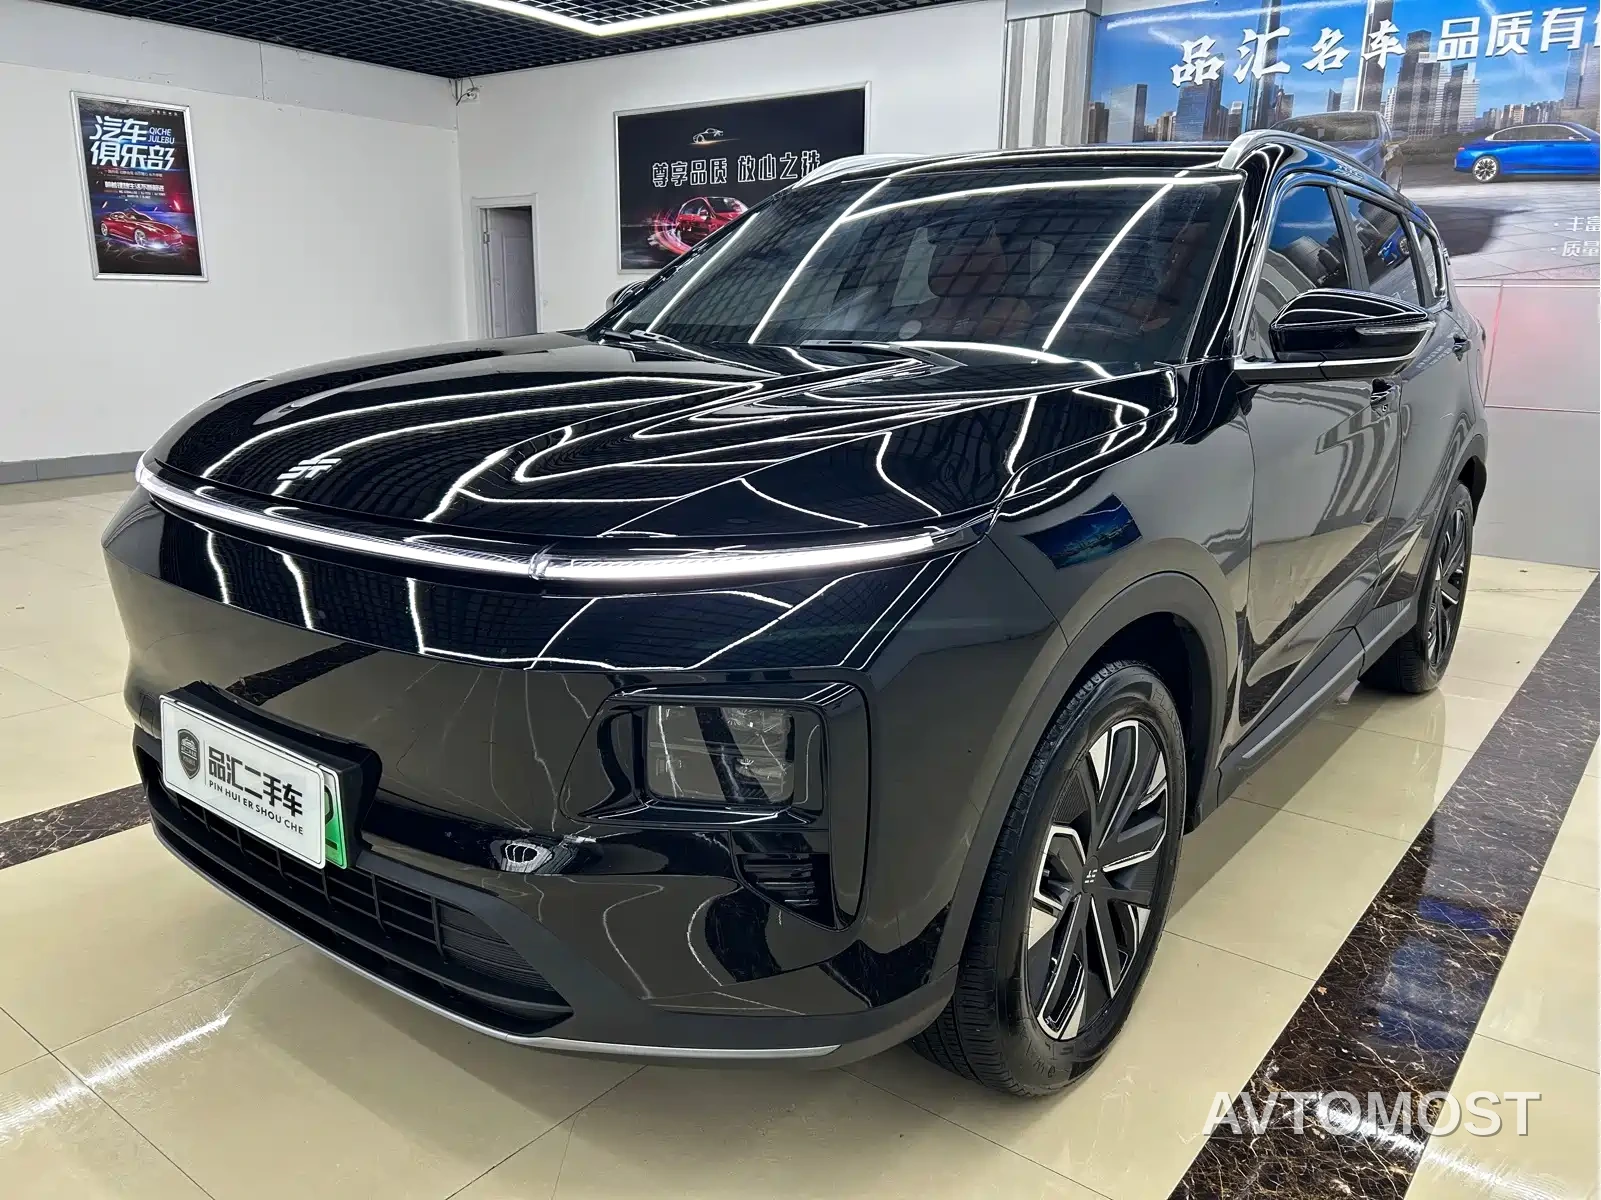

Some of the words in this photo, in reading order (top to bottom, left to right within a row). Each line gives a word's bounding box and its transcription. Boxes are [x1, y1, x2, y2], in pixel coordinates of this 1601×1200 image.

[1437, 6, 1600, 61] 品质有
[1170, 19, 1406, 87] 品汇名车
[89, 115, 149, 144] 汽车
[147, 135, 175, 145] JULEBU
[149, 126, 172, 137] QICHE
[90, 140, 175, 171] 俱乐部
[652, 157, 728, 188] 尊享品质
[208, 745, 303, 817] 品汇二手车
[209, 780, 223, 793] PIN
[225, 788, 241, 803] HUI
[242, 797, 254, 810] ER
[255, 804, 282, 824] SHOU
[284, 819, 304, 836] CHE
